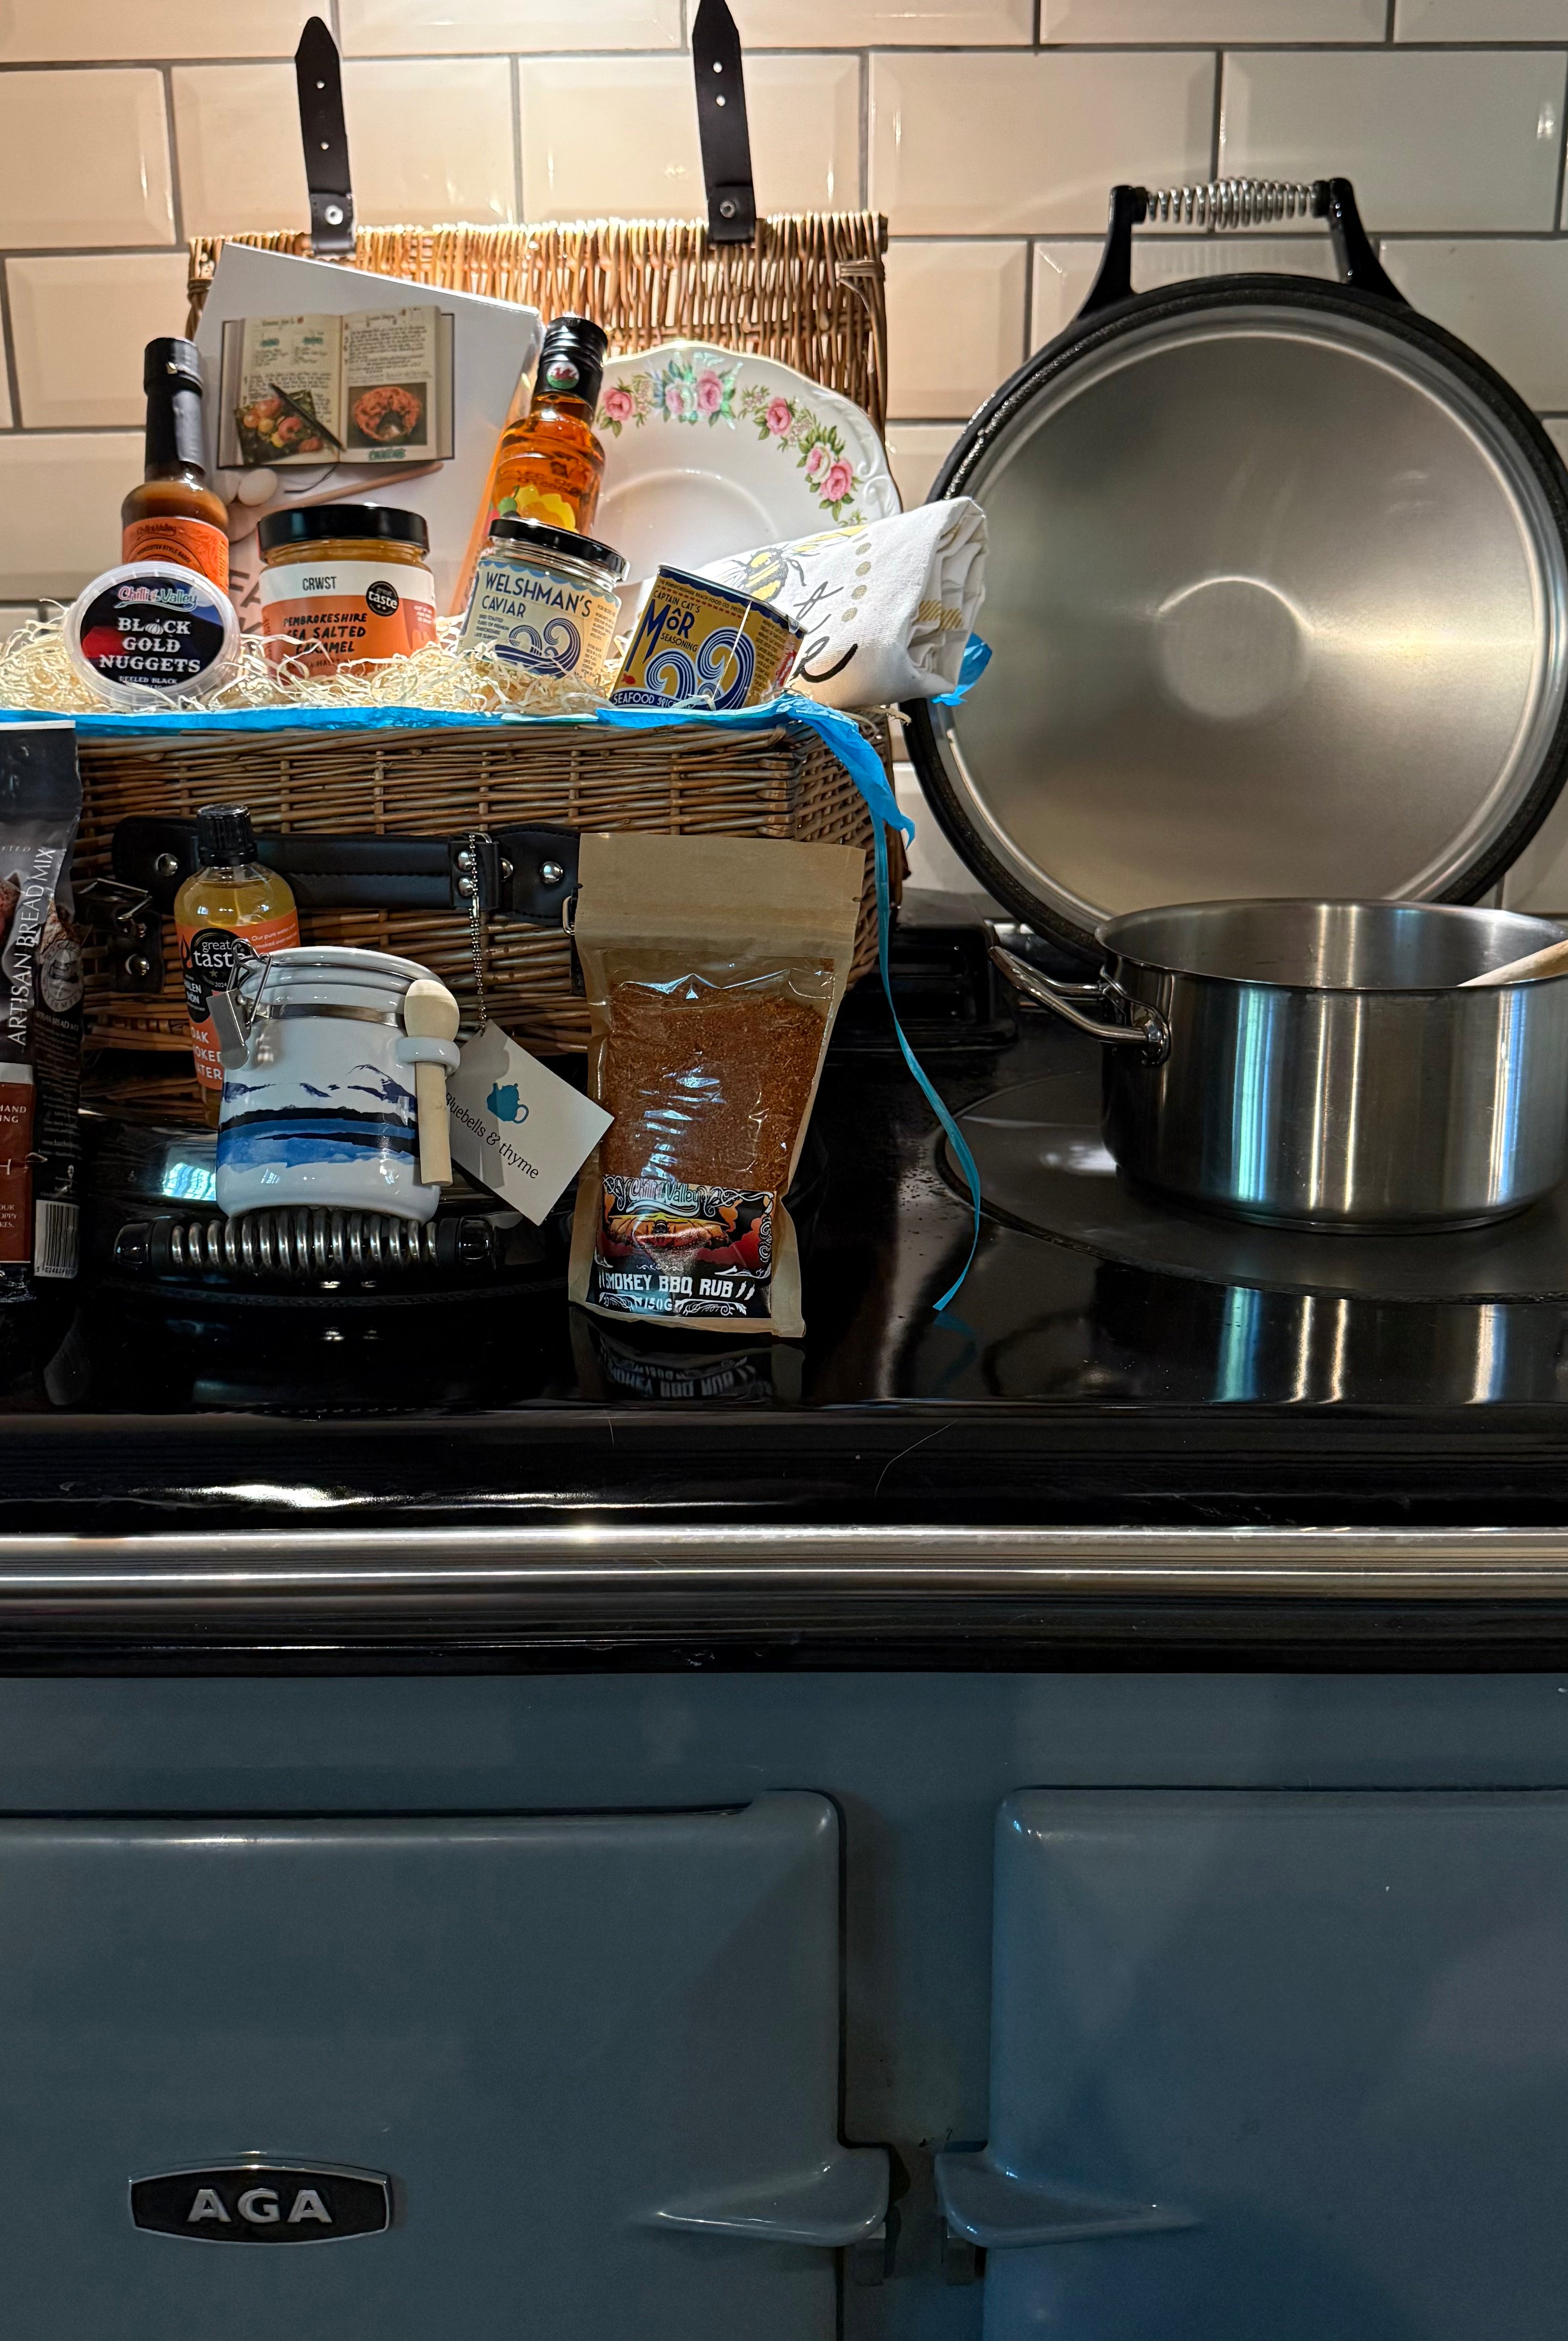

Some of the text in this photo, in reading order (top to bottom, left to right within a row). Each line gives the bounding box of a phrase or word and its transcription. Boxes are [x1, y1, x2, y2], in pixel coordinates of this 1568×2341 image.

[303, 577, 337, 590] CRWST
[118, 586, 149, 601] Chilli
[160, 588, 197, 606] Valley
[368, 591, 398, 609] taste
[485, 572, 592, 617] WELSHMAN'S
[653, 590, 701, 613] CAPTAIN CAT'S
[708, 596, 722, 606] FOOD
[482, 596, 526, 618] CAVIAR
[284, 613, 368, 626] PEMBROKESHIRE
[287, 626, 366, 640] SEA SALTED
[122, 637, 181, 652] GOLD
[660, 632, 699, 653] SEASONING
[100, 654, 201, 672] NUGGETS
[152, 677, 178, 685] BLACK
[613, 692, 654, 704] SEAFOOD
[8, 849, 56, 1046] ARTISAN BREAD MIX
[202, 940, 232, 953] great
[190, 1026, 209, 1044] OAK
[486, 1132, 500, 1145] &
[499, 1143, 539, 1179] thyme
[665, 1181, 701, 1204] Valley
[605, 1273, 733, 1298] SMOKEY BBQ RUB
[644, 1297, 673, 1312] 150G
[187, 2188, 333, 2224] AGA
